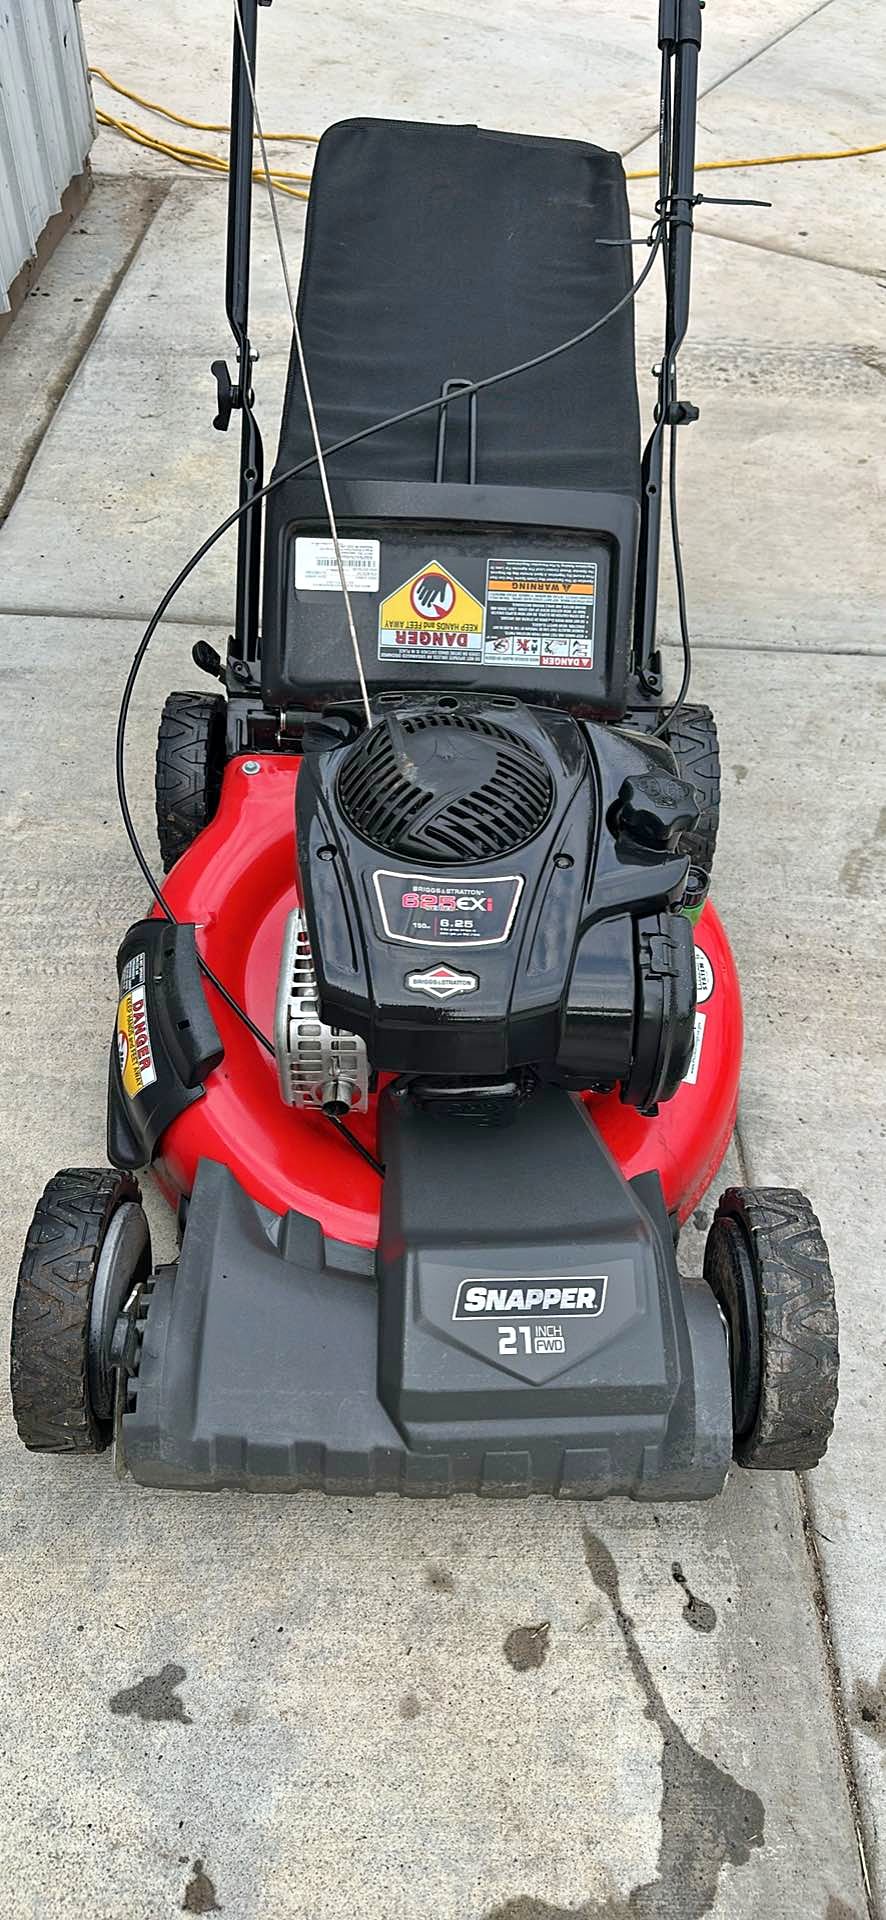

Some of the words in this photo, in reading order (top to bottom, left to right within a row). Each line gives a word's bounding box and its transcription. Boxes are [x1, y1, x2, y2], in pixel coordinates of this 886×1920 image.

[511, 582, 559, 591] WARNING
[385, 620, 404, 628] AWAY
[406, 621, 422, 629] FEET
[436, 622, 459, 630] HANDS
[395, 631, 469, 647] DANGER
[542, 656, 580, 665] DANGER
[440, 919, 473, 928] 6.25
[126, 996, 134, 1011] KEEP
[126, 1014, 135, 1035] HANDS
[132, 999, 152, 1073] DANGER
[129, 1048, 139, 1066] FEET
[132, 1067, 142, 1088] AWAY
[464, 1286, 597, 1312] SNAPPER
[498, 1325, 533, 1355] 21
[535, 1325, 562, 1337] INCH
[536, 1339, 563, 1351] FWD
